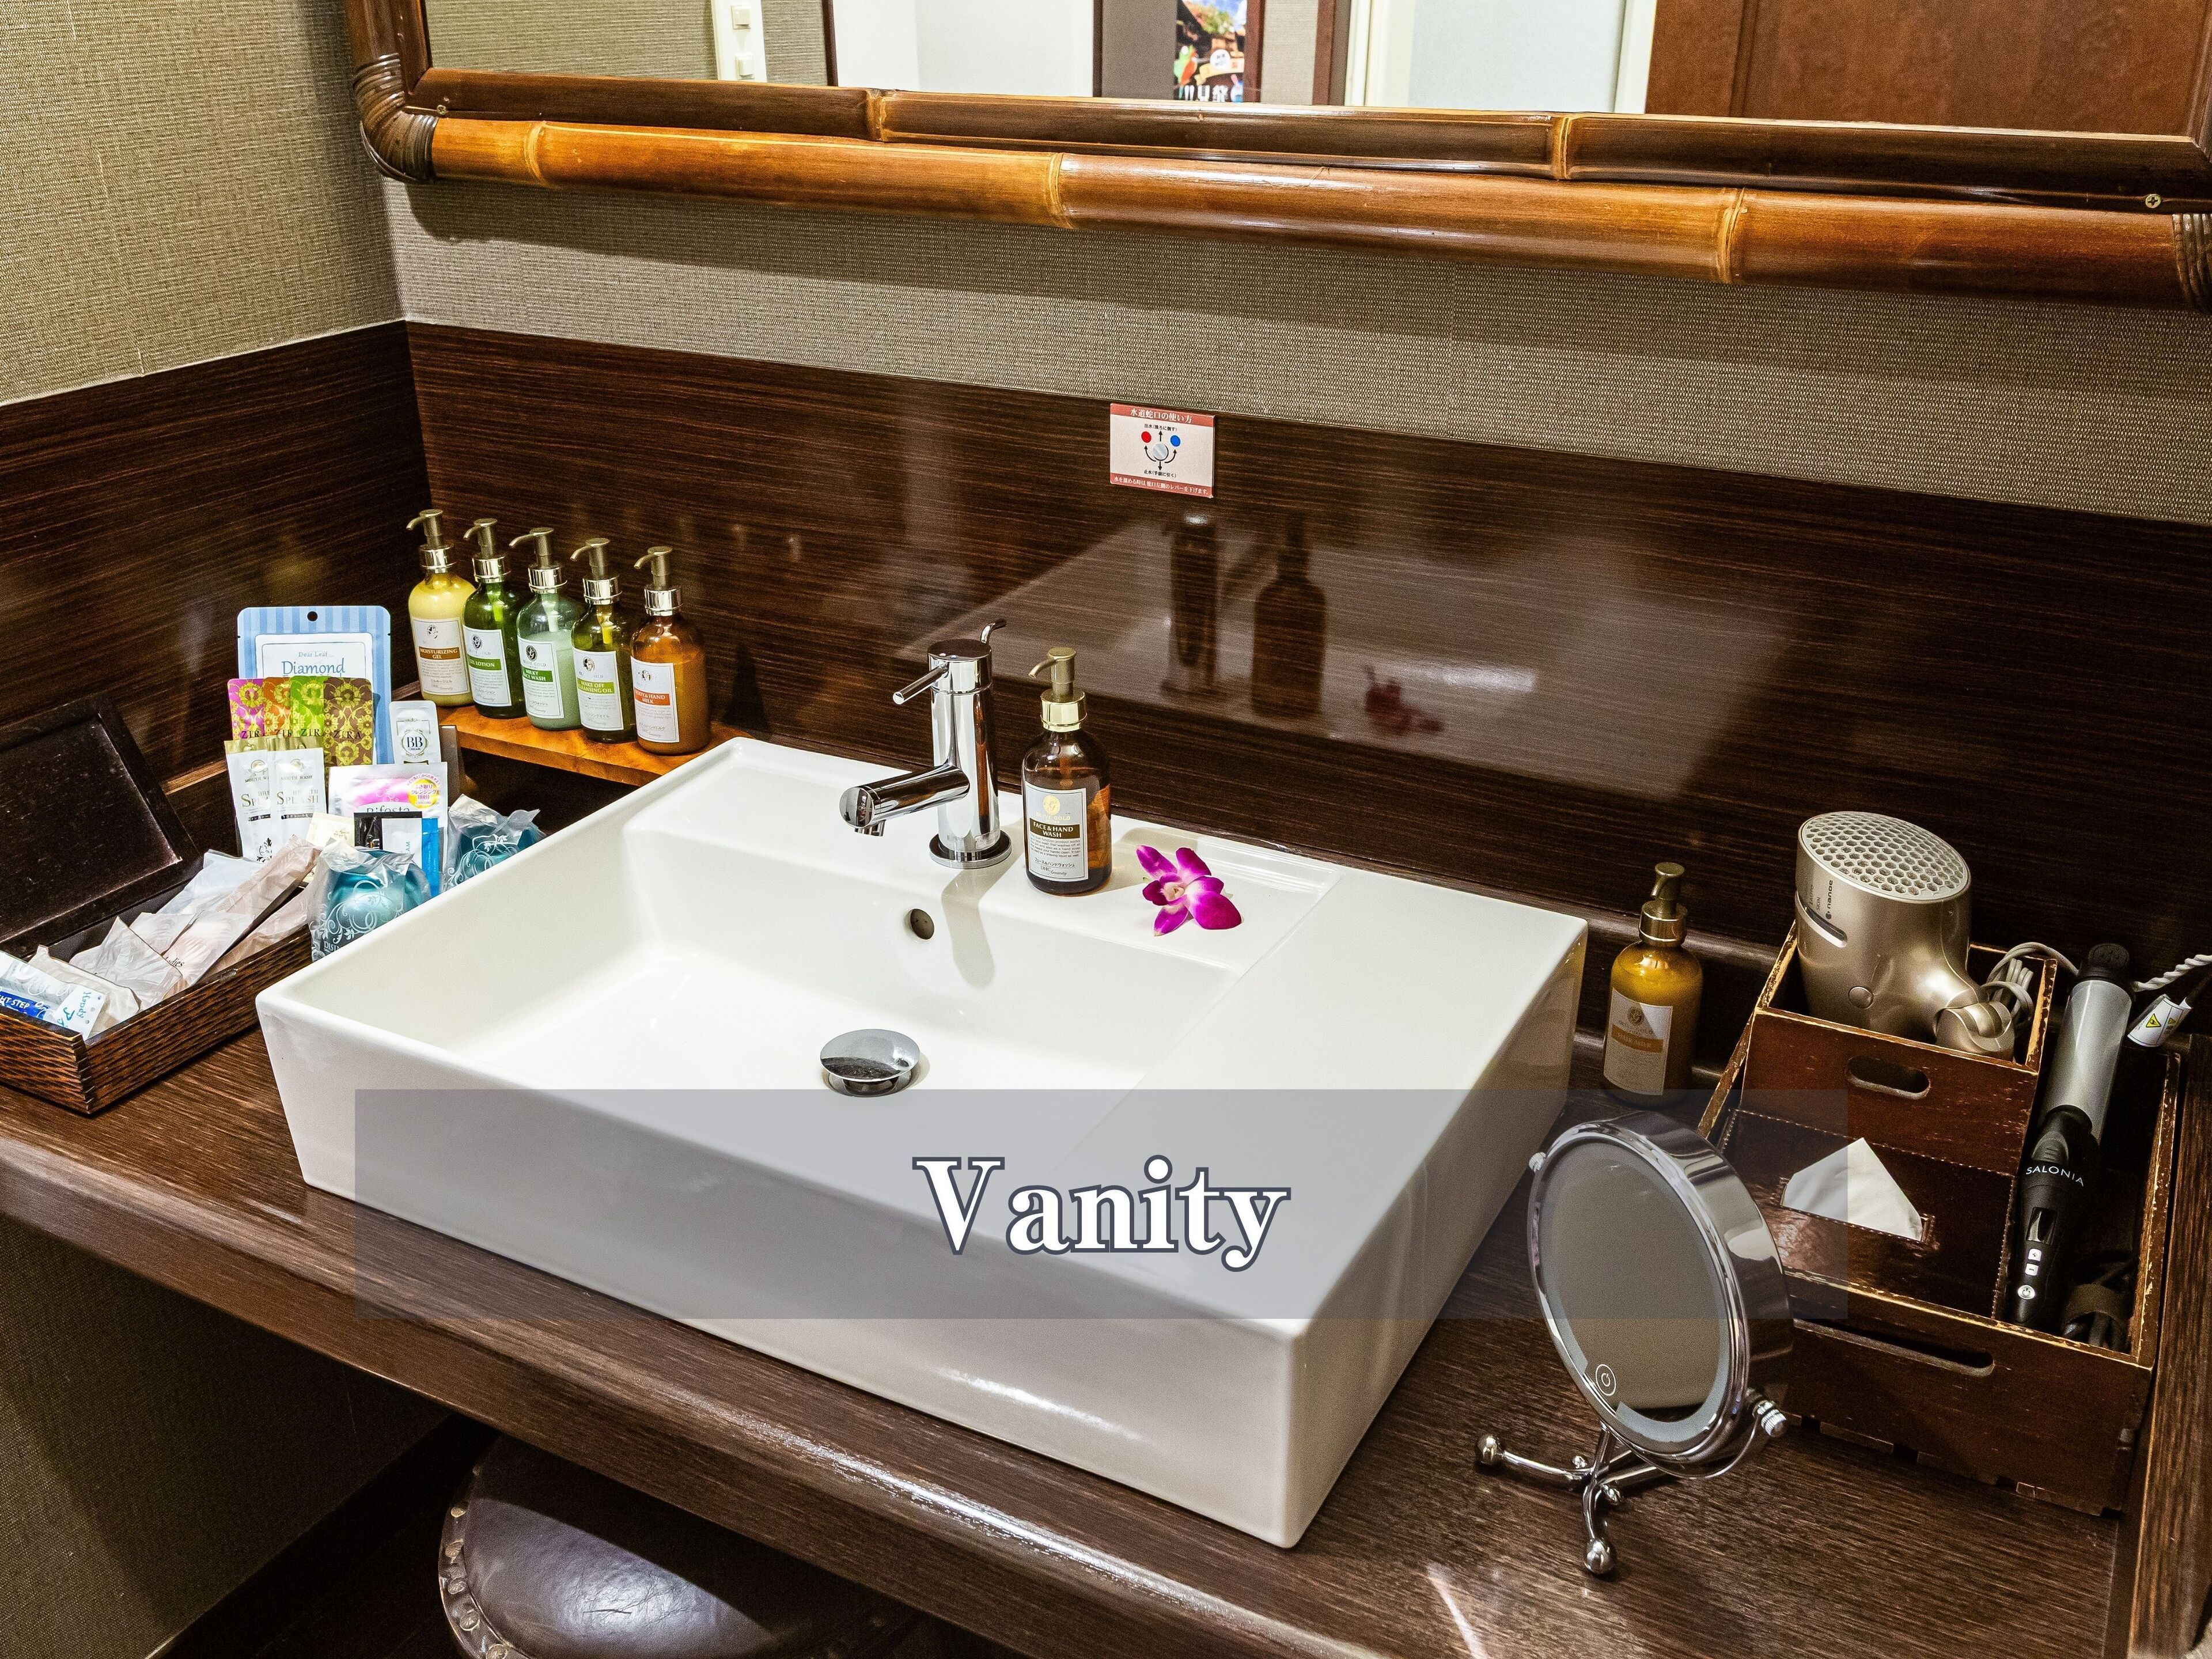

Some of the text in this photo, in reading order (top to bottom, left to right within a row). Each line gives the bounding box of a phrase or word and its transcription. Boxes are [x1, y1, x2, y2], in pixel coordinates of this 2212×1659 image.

[1130, 408, 1192, 423] 水道蛇口の使い方
[281, 657, 346, 675] Diamond
[241, 730, 265, 739] ZIR
[301, 728, 324, 737] ZIR
[334, 730, 362, 739] ZIRA
[407, 737, 423, 748] BB
[1042, 830, 1062, 838] WASH
[11, 999, 31, 1009] STEP
[77, 991, 92, 1018] Handy
[2026, 1165, 2084, 1187] SALONIA
